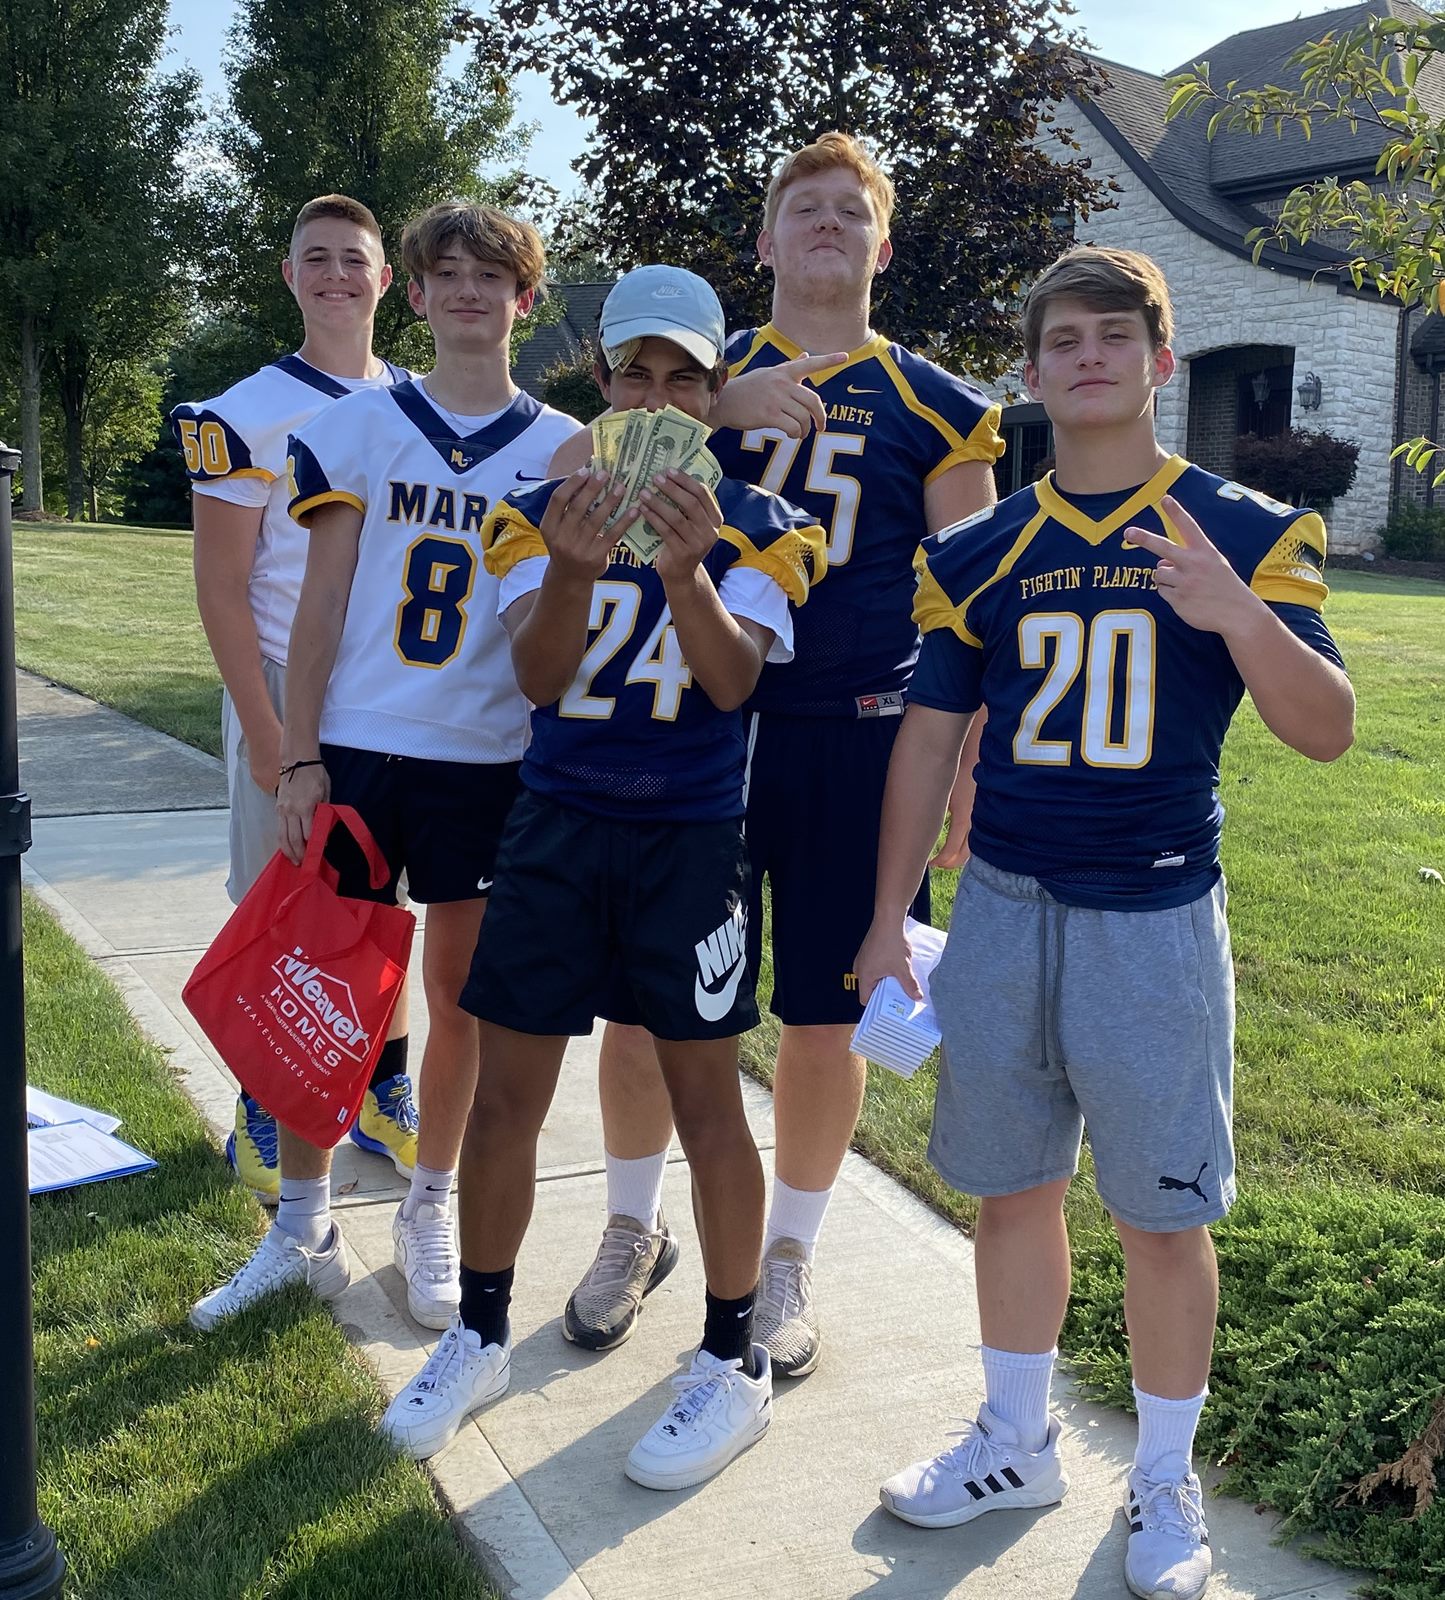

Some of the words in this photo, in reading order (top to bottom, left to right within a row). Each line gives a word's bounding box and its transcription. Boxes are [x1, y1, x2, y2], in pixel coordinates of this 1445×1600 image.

[658, 285, 685, 296] NIKE
[823, 402, 874, 426] LANETS
[178, 419, 232, 475] 50
[386, 480, 489, 531] MAR
[708, 471, 719, 488] 20
[740, 427, 866, 566] 75
[393, 532, 479, 670] 8
[1020, 567, 1086, 600] FIGHTIN'
[558, 579, 693, 721] 24
[882, 697, 895, 705] XL
[1012, 608, 1157, 770] 20
[283, 946, 369, 1047] Weaver
[843, 973, 857, 991] OT
[270, 984, 342, 1068] HOMES
